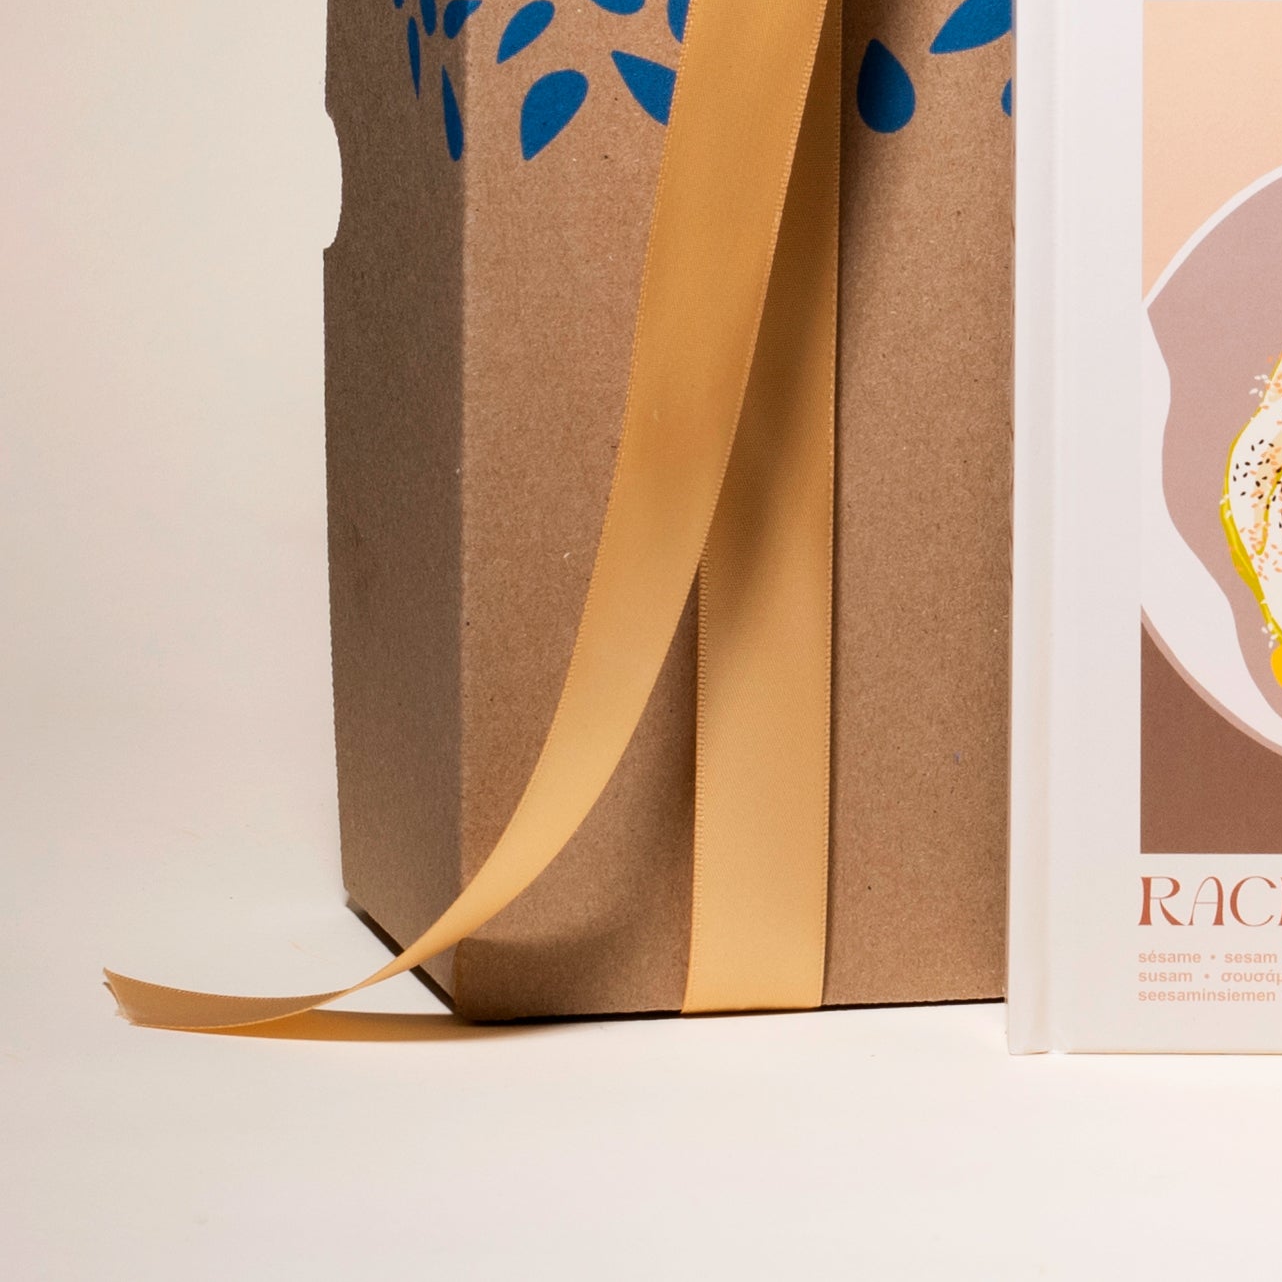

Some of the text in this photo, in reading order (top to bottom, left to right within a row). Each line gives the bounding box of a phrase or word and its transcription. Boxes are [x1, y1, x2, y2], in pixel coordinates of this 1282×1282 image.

[1138, 949, 1202, 964] sésame
[1224, 952, 1278, 964] sesam
[1138, 971, 1193, 983] susam
[1138, 987, 1276, 1002] seesaminsiemen
